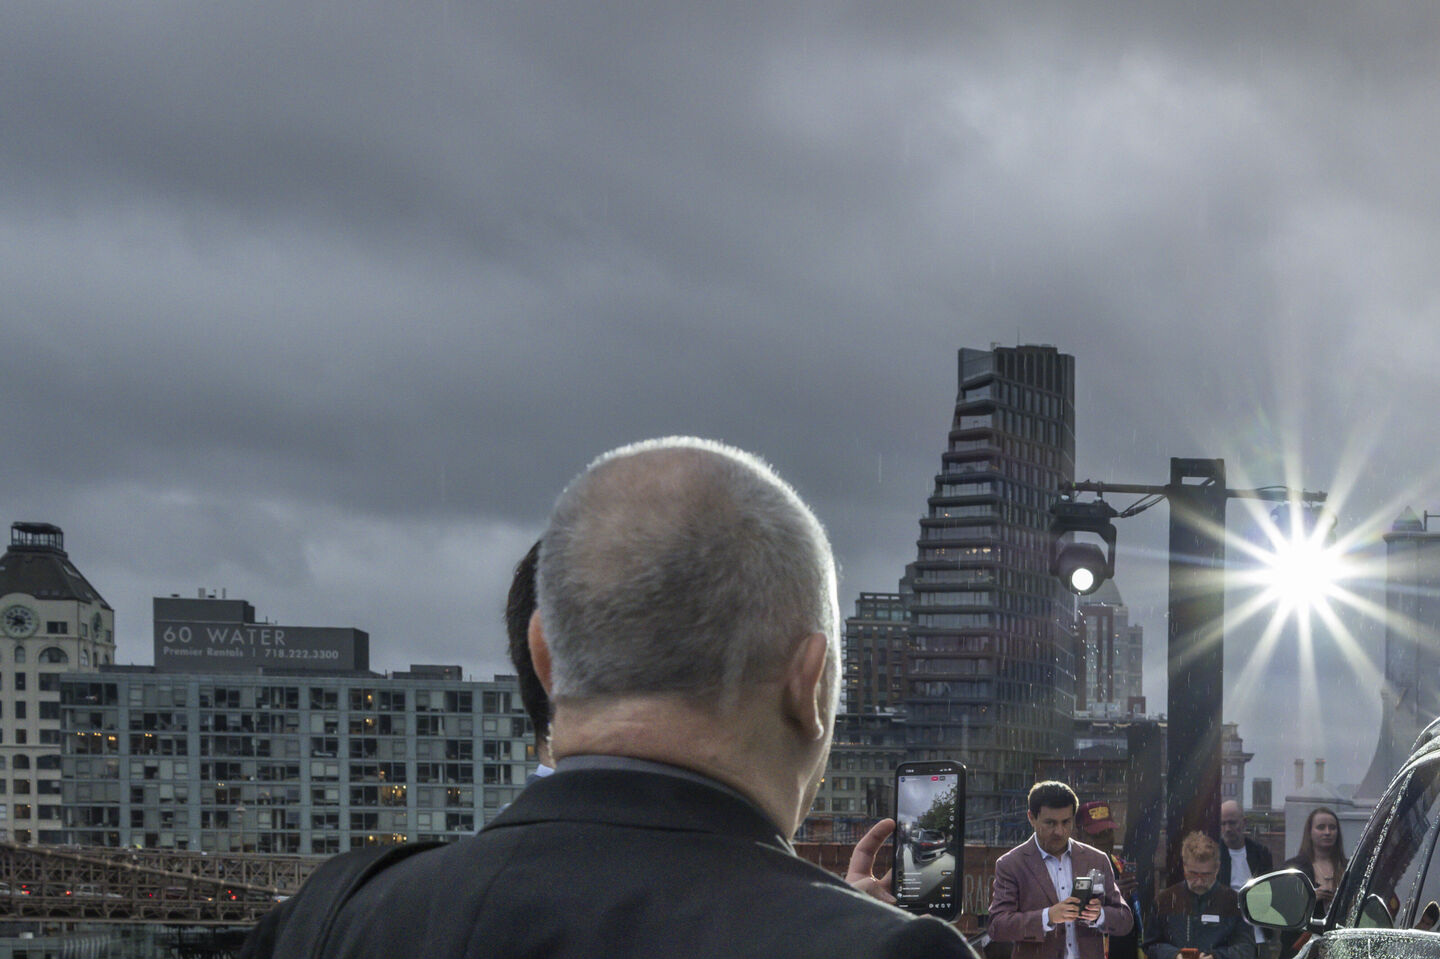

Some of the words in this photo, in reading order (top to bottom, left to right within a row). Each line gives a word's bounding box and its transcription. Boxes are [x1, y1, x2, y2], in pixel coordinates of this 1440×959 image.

[163, 626, 192, 643] 60
[207, 628, 286, 646] WATER
[163, 647, 203, 657] Premier
[207, 647, 243, 657] Rentals
[265, 648, 339, 659] 718.222.3300
